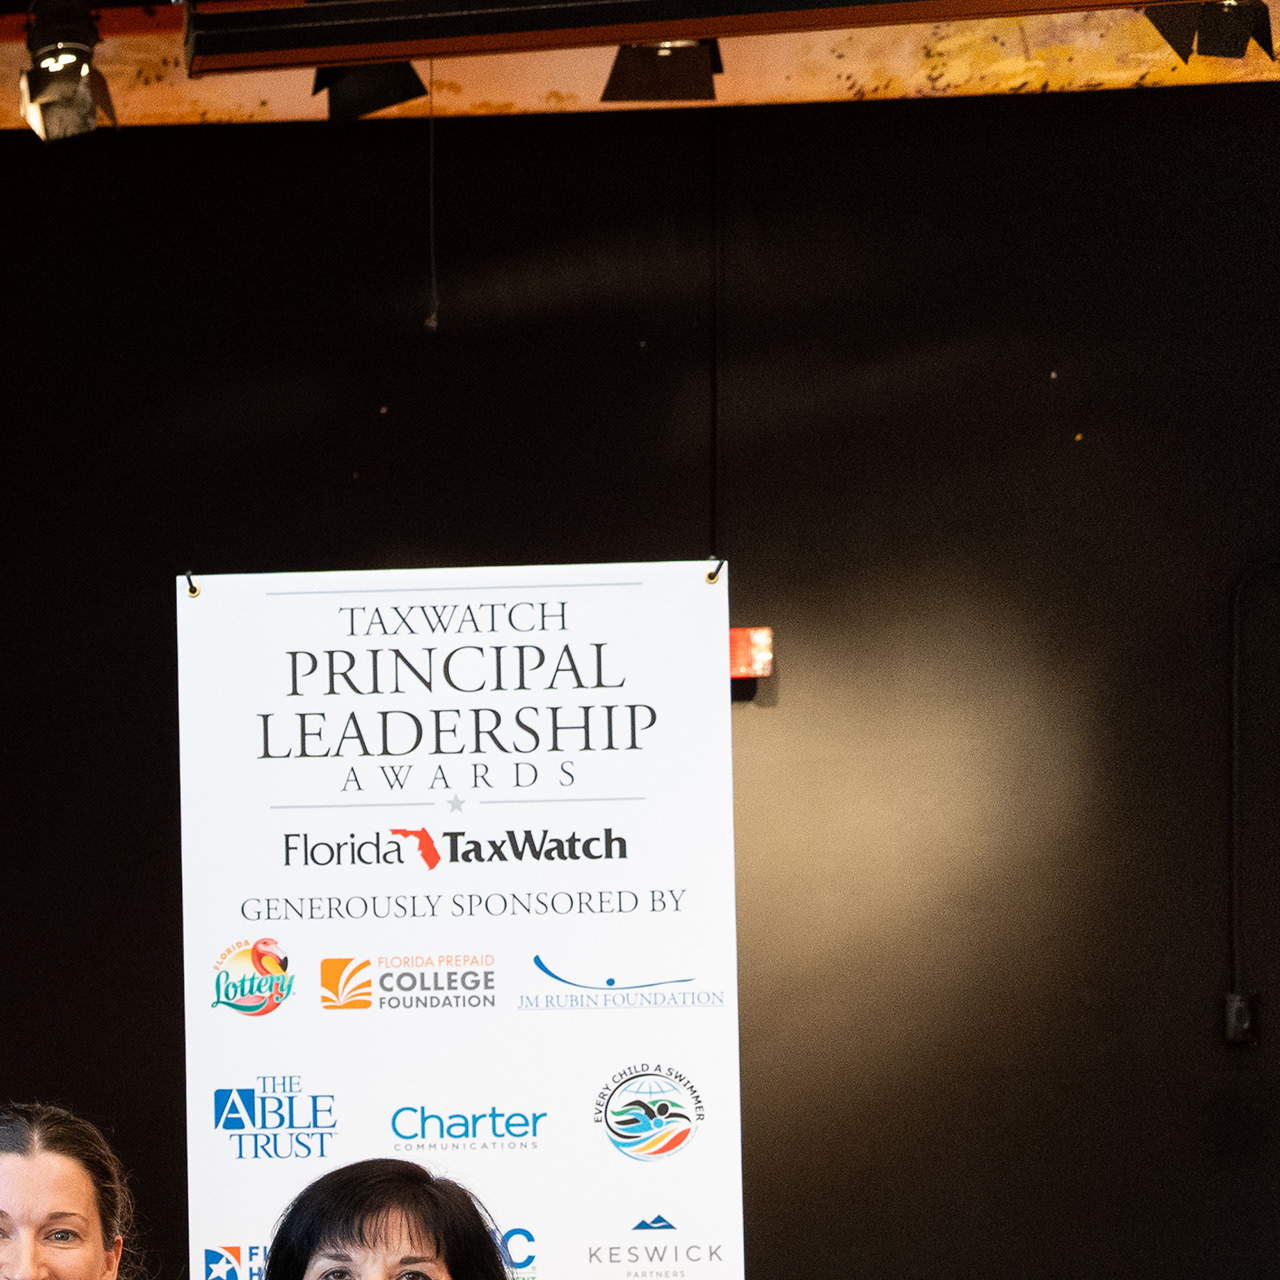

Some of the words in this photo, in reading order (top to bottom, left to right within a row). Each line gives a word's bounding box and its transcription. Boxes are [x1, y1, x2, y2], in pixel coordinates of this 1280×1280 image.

[339, 601, 569, 637] TAXWATCH
[286, 643, 626, 696] PRINCIPAL
[257, 704, 656, 759] LEADERSHIP
[342, 760, 575, 792] AWARDS
[283, 833, 404, 866] Florida
[442, 828, 627, 862] TaxWatch
[241, 894, 443, 920] GENEROUSLY
[451, 890, 639, 917] SPONSORED
[651, 889, 686, 912] BY
[213, 939, 250, 971] FLORIDA
[378, 956, 434, 968] FLORIDA
[438, 954, 495, 967] PREPAID
[211, 970, 296, 1013] Lottery
[379, 971, 495, 992] COLLEGE
[379, 995, 495, 1009] FOUNDATION
[518, 995, 539, 1009] JM
[545, 993, 599, 1008] RUBIN
[603, 991, 724, 1007] FOUNDATION
[256, 1075, 302, 1094] THE
[593, 1083, 612, 1123] EVERY
[611, 1063, 650, 1084] CHILD
[654, 1064, 662, 1073] A
[665, 1067, 705, 1121] SWIMMER
[391, 1106, 547, 1140] Charter
[229, 1132, 334, 1159] TRUST
[393, 1141, 538, 1152] COMMUNICATIONS
[588, 1245, 723, 1263] KESWICK
[626, 1270, 685, 1279] PARTNERS
